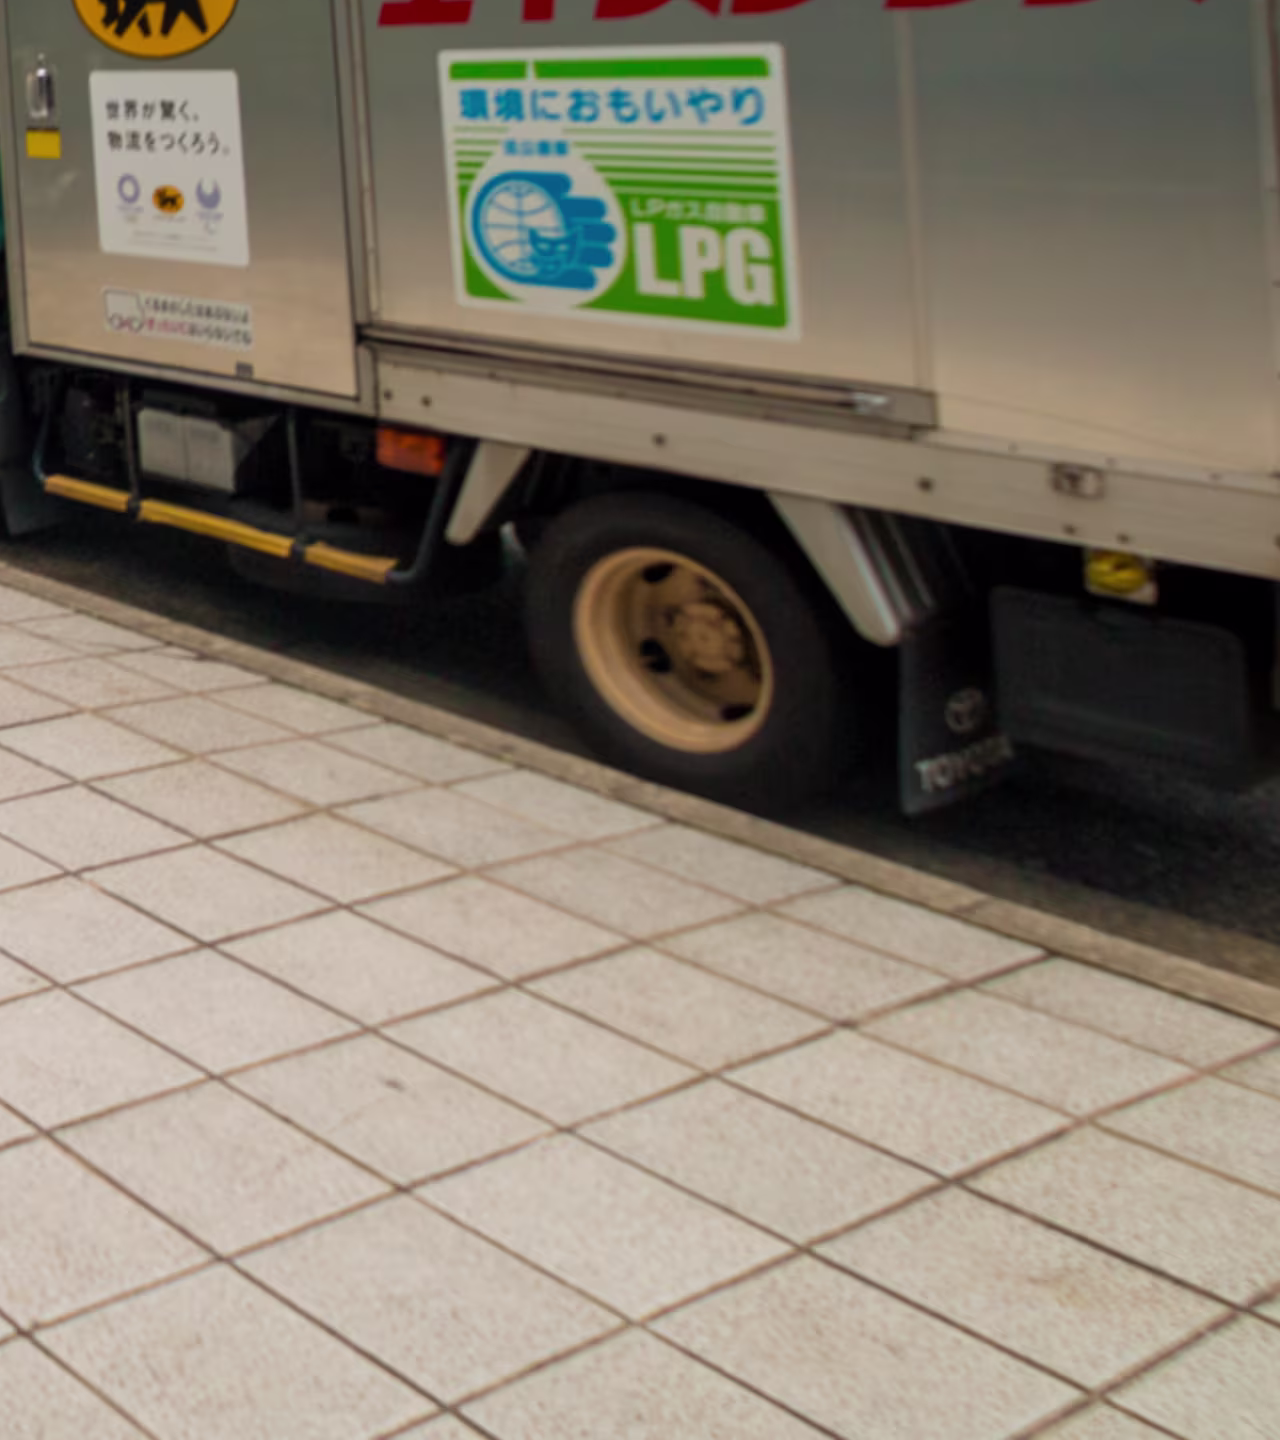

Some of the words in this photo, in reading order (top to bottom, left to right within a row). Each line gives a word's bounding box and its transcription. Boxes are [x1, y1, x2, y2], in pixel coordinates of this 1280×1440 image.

[106, 100, 200, 122] 世界が驚く。
[459, 87, 766, 125] 環境におもいやり
[108, 130, 230, 155] 物流をつくろう。
[633, 222, 776, 306] LPG
